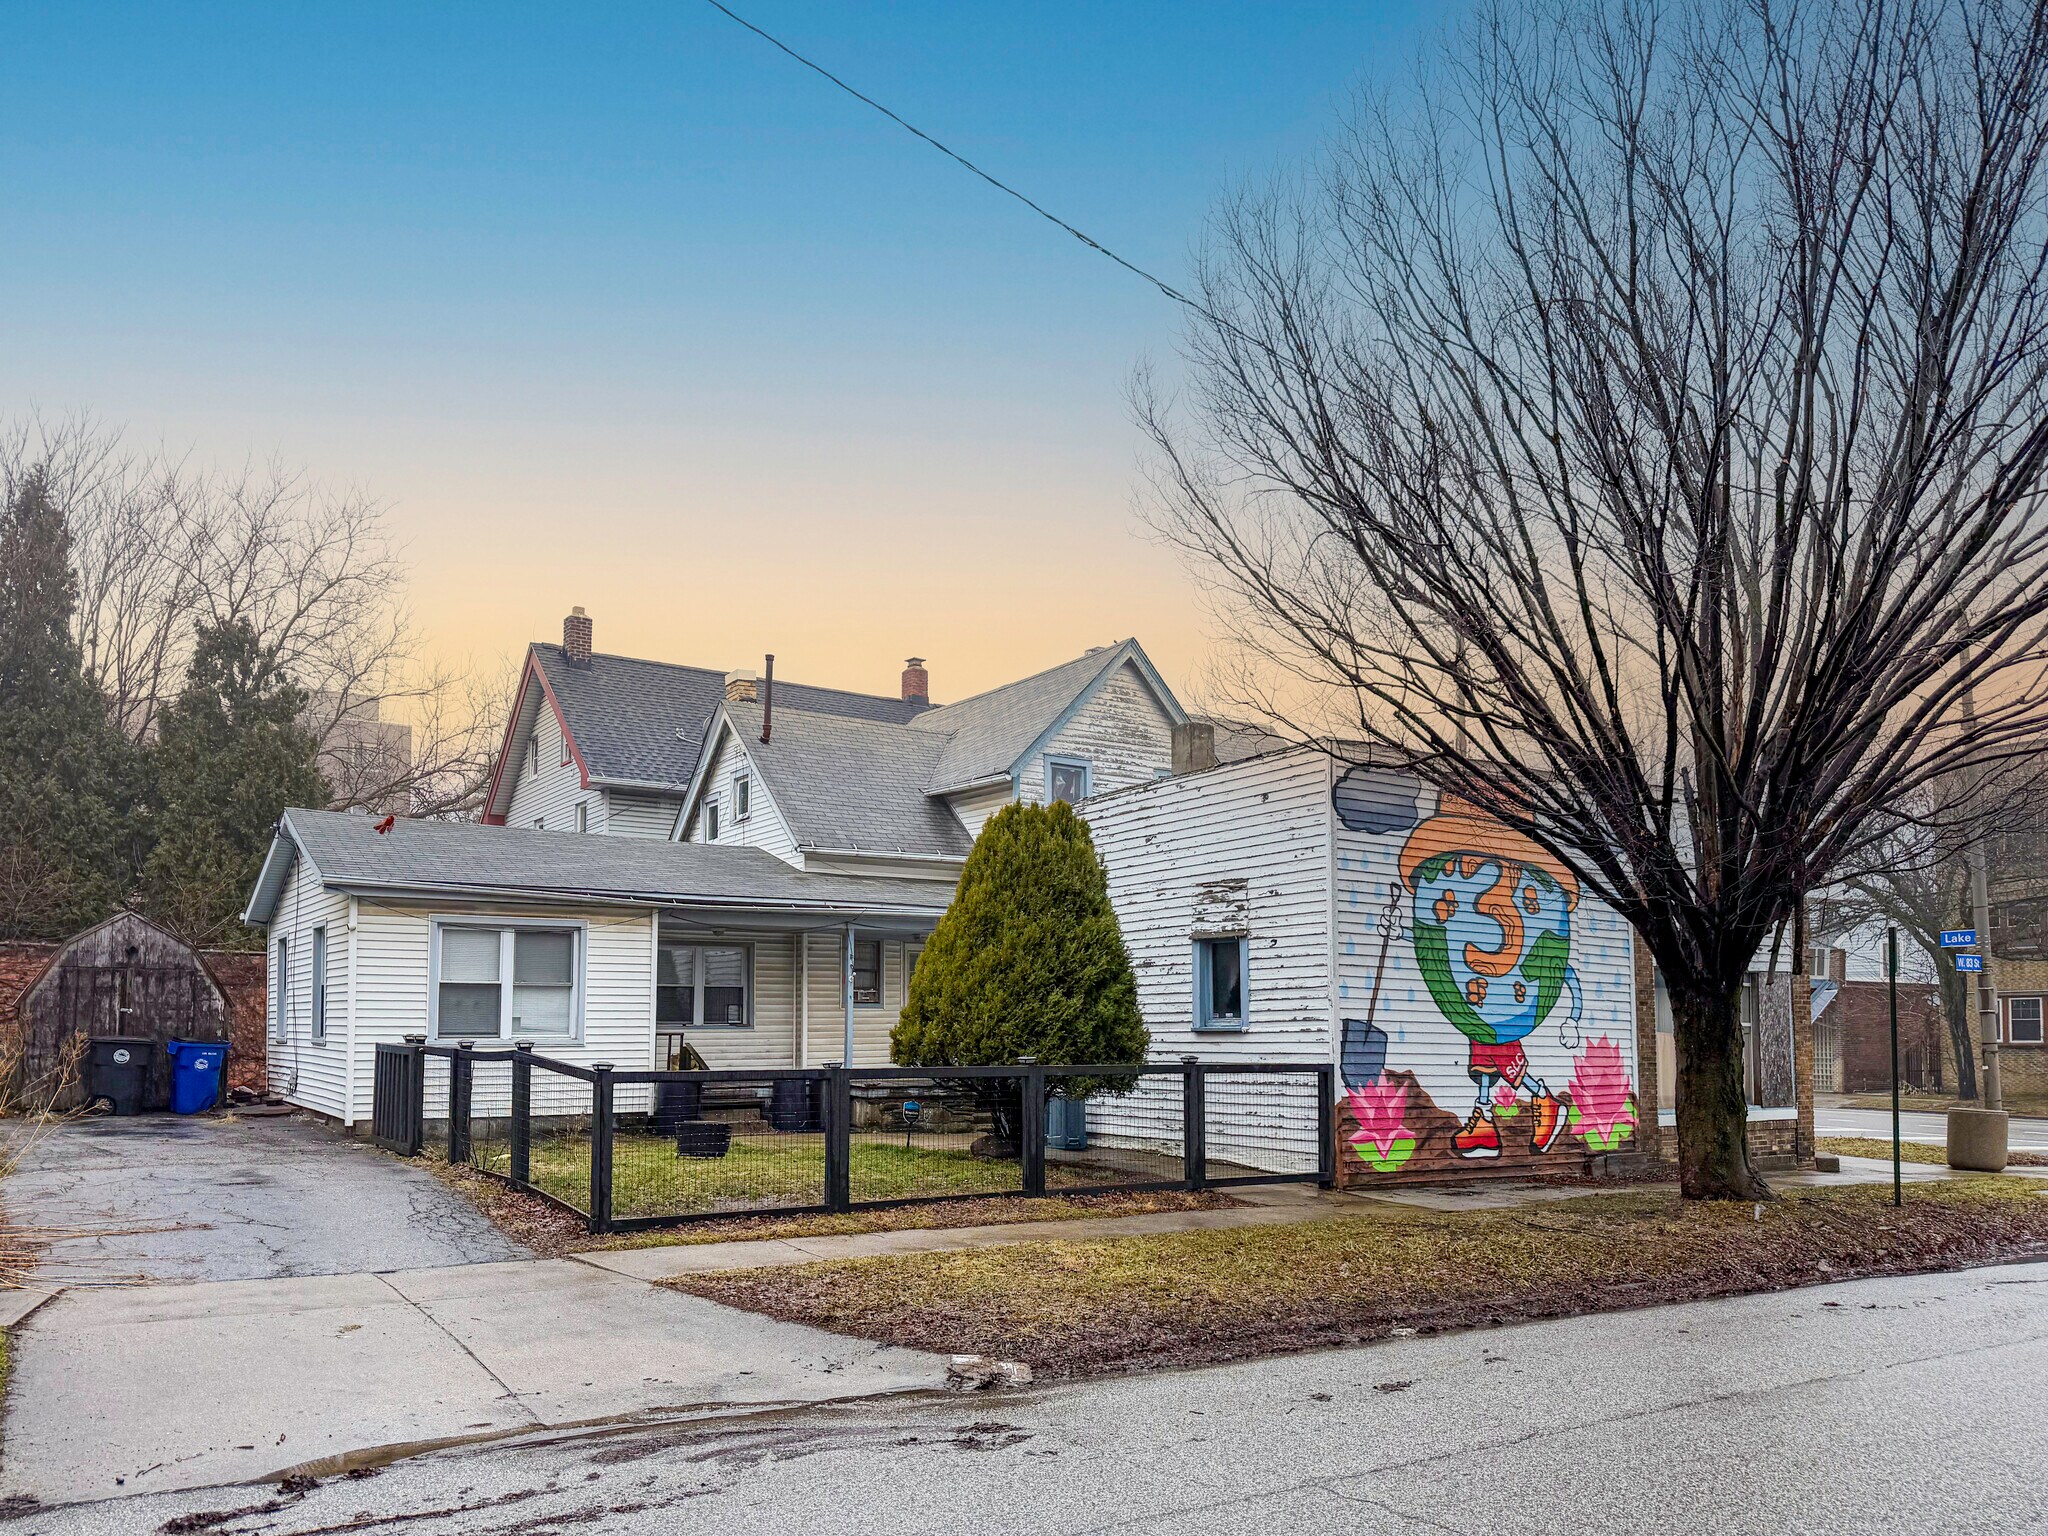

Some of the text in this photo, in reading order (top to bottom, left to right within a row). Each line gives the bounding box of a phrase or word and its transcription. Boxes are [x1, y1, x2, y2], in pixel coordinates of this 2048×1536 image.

[1944, 933, 1972, 944] Lake
[1957, 957, 1981, 969] W. 83 St
[1505, 1052, 1525, 1079] SLC
